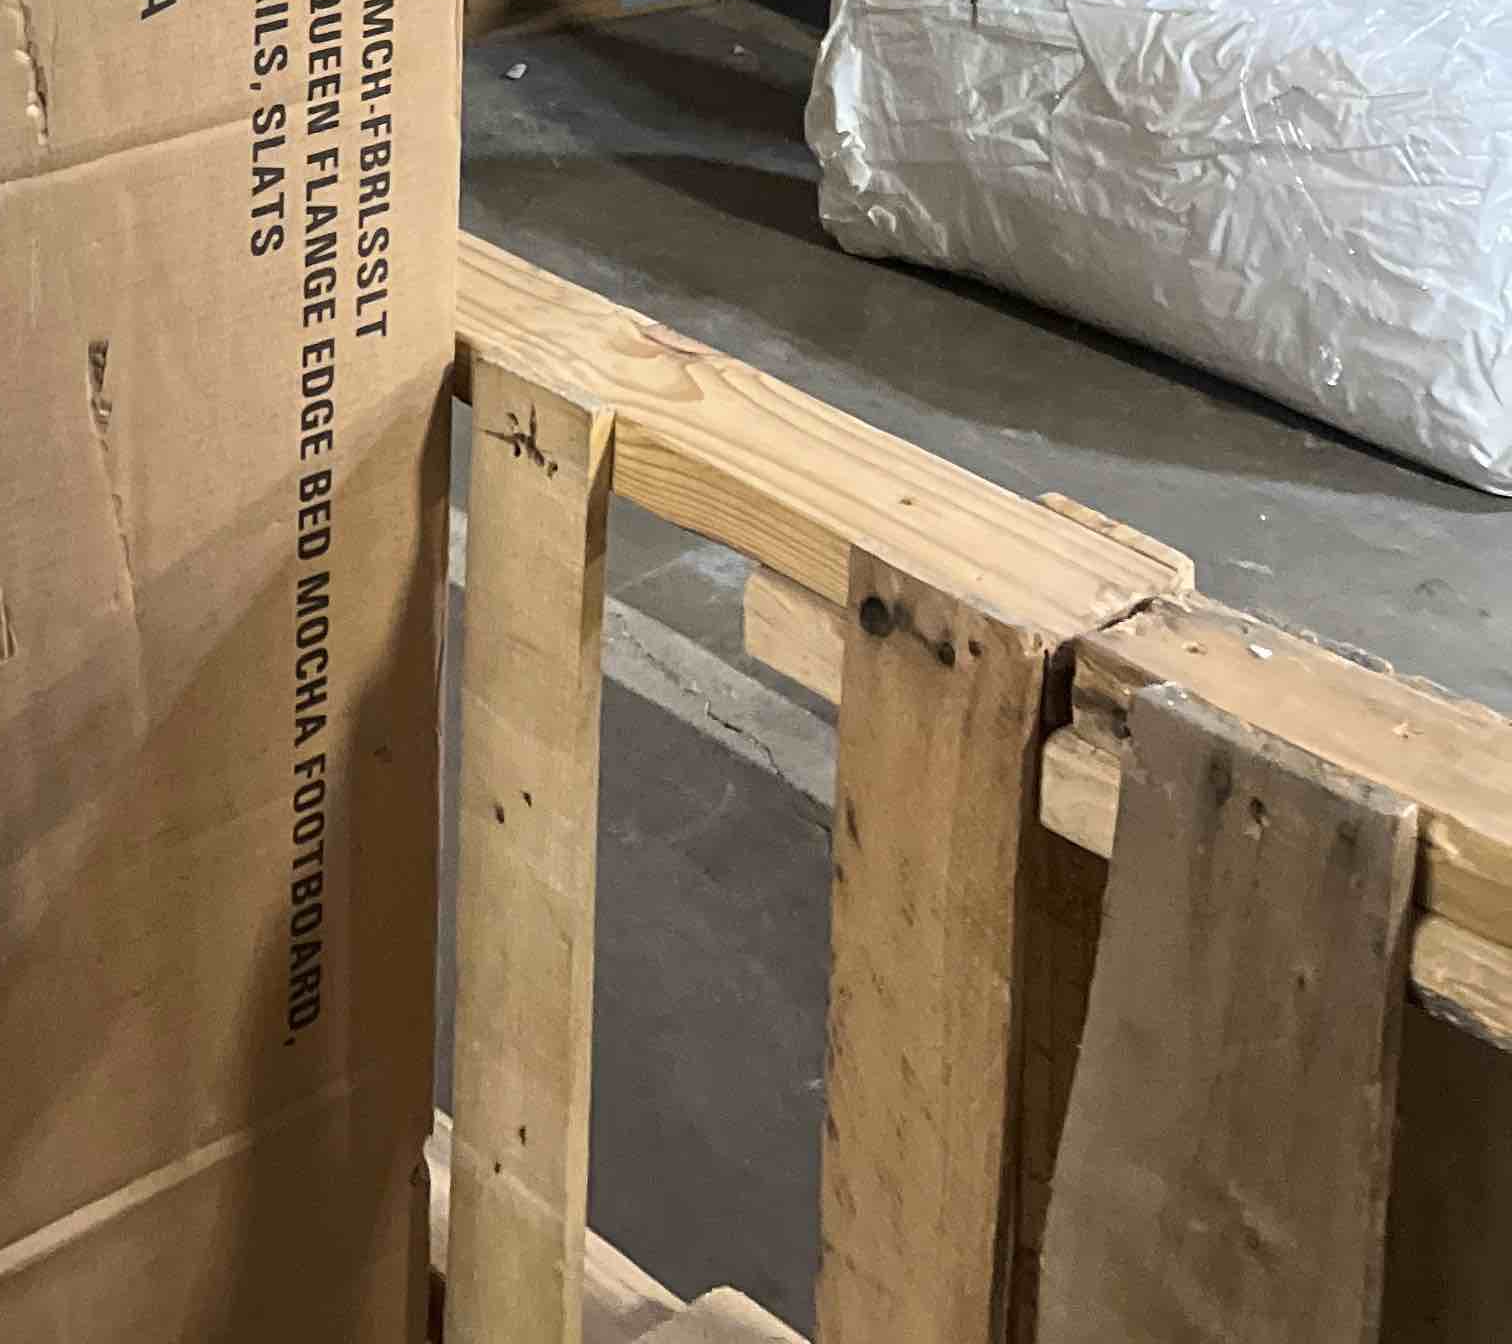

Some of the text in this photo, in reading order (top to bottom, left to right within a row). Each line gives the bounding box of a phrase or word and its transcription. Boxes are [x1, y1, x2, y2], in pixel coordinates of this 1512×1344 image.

[249, 103, 286, 258] SLATS
[302, 150, 340, 329] FLANGE
[298, 337, 336, 461] EDGE
[296, 469, 333, 561] BED
[293, 570, 331, 747] MOCHA
